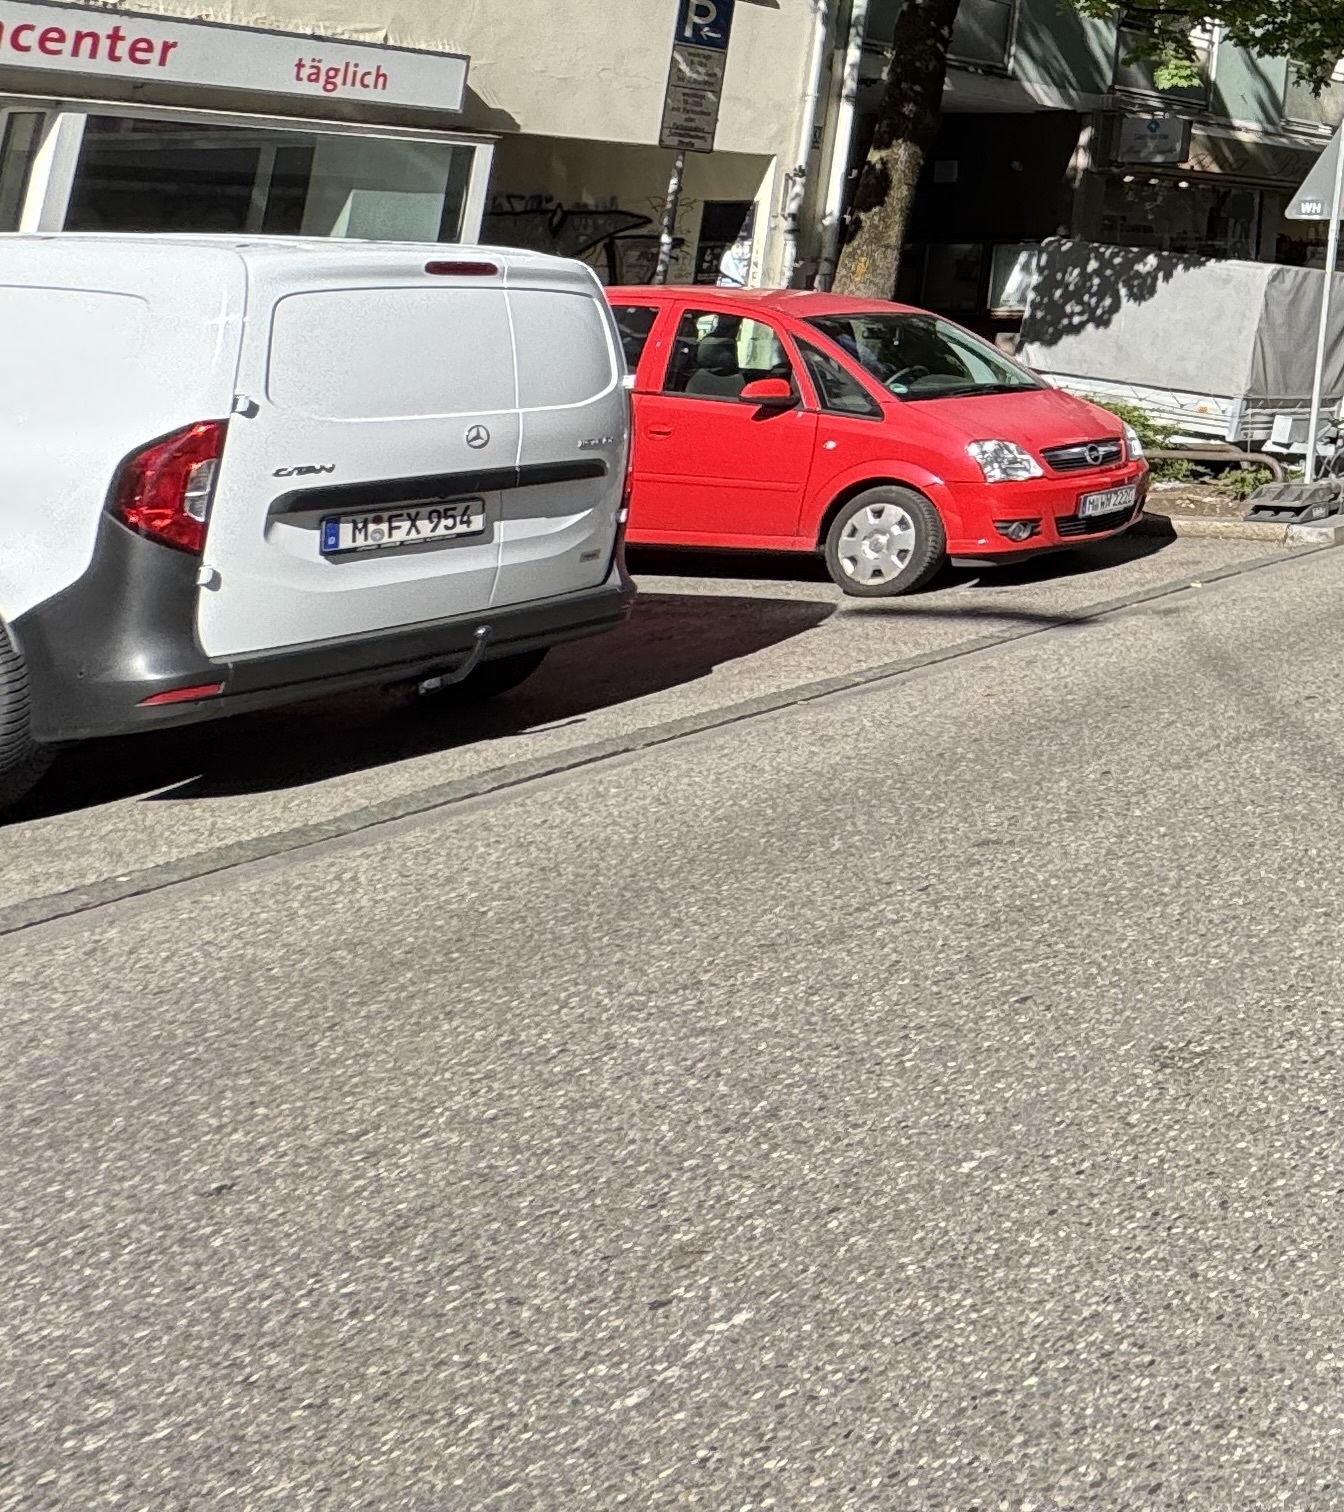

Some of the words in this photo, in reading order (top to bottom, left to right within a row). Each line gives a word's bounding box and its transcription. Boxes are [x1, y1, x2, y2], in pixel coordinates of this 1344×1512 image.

[0, 22, 179, 68] center
[293, 56, 389, 92] täglich
[1301, 202, 1322, 214] WH
[351, 517, 369, 544] M
[386, 513, 422, 539] FX
[427, 505, 473, 534] 954
